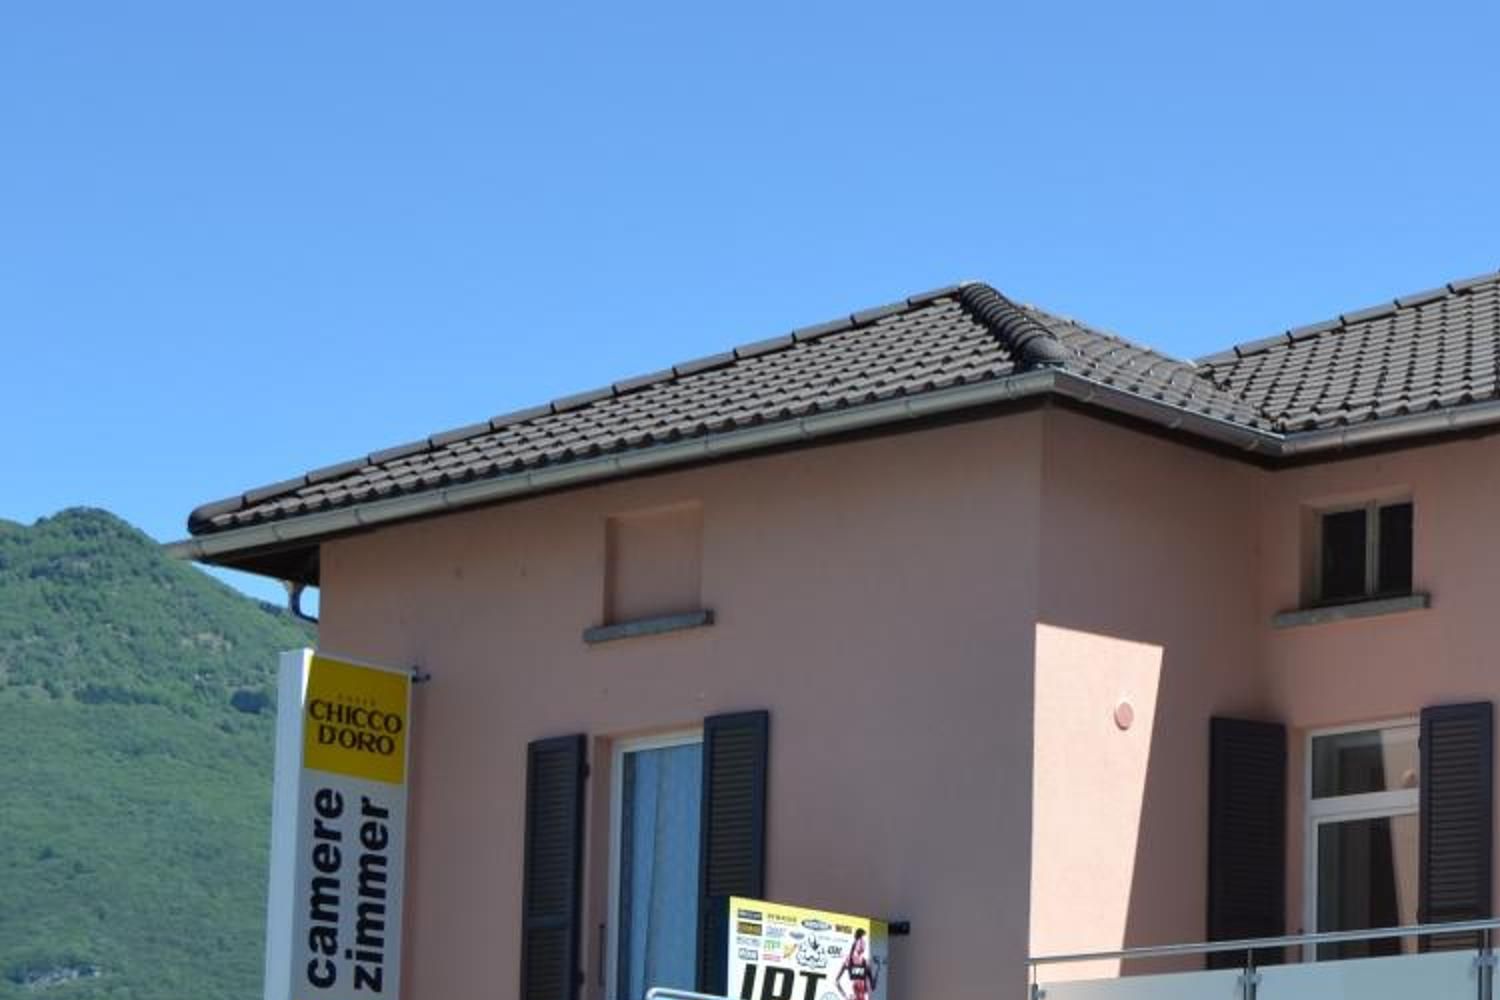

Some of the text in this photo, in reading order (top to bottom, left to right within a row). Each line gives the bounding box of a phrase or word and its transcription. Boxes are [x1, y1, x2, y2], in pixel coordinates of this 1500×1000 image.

[309, 699, 403, 734] CHICCO
[318, 724, 396, 756] D'ORO
[307, 787, 344, 989] camere
[345, 796, 389, 993] zimmer
